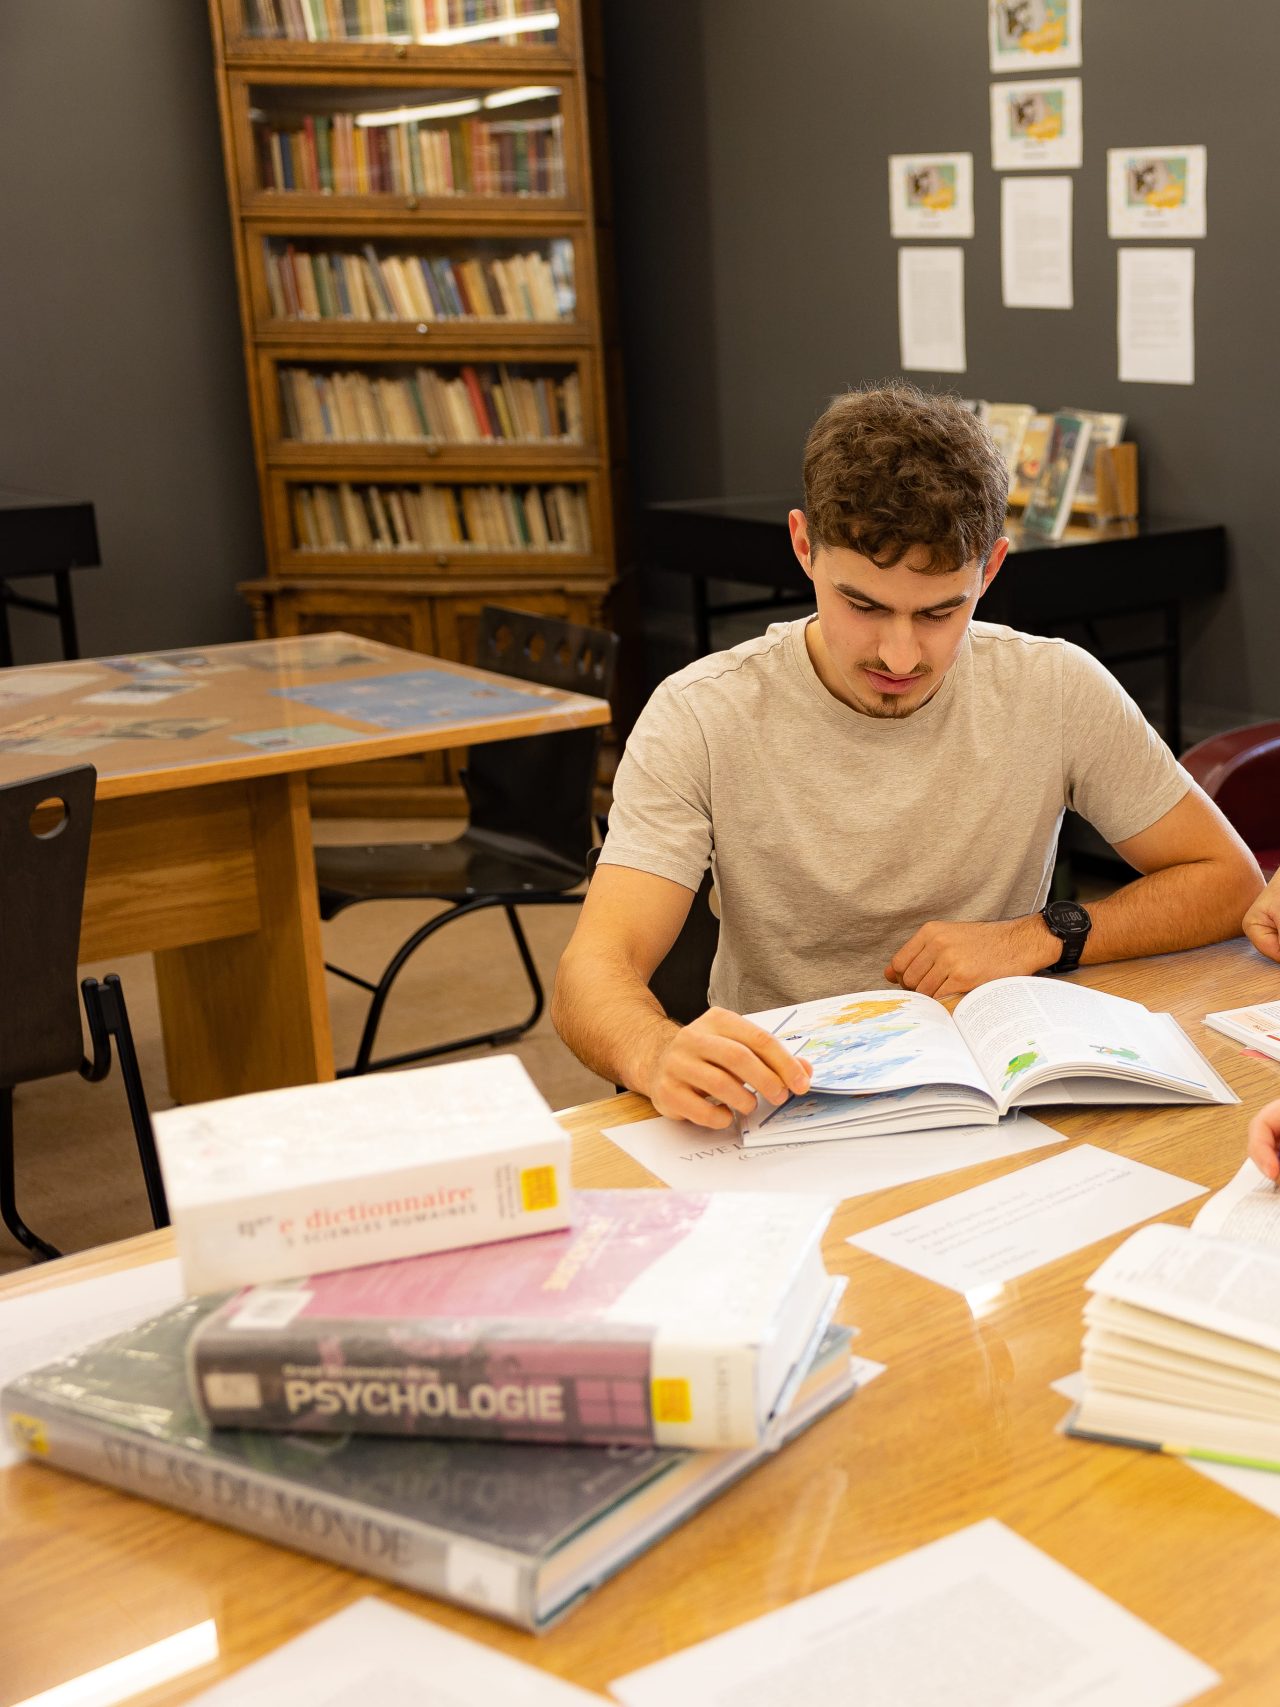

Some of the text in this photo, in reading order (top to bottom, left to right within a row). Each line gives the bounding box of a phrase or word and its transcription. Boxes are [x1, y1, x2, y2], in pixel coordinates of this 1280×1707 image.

[680, 1144, 731, 1163] VIVE
[304, 1183, 476, 1232] dictionnaire
[283, 1378, 567, 1423] PSYCHOLOGIE
[211, 1467, 266, 1513] DU
[267, 1481, 419, 1567] MONDE
